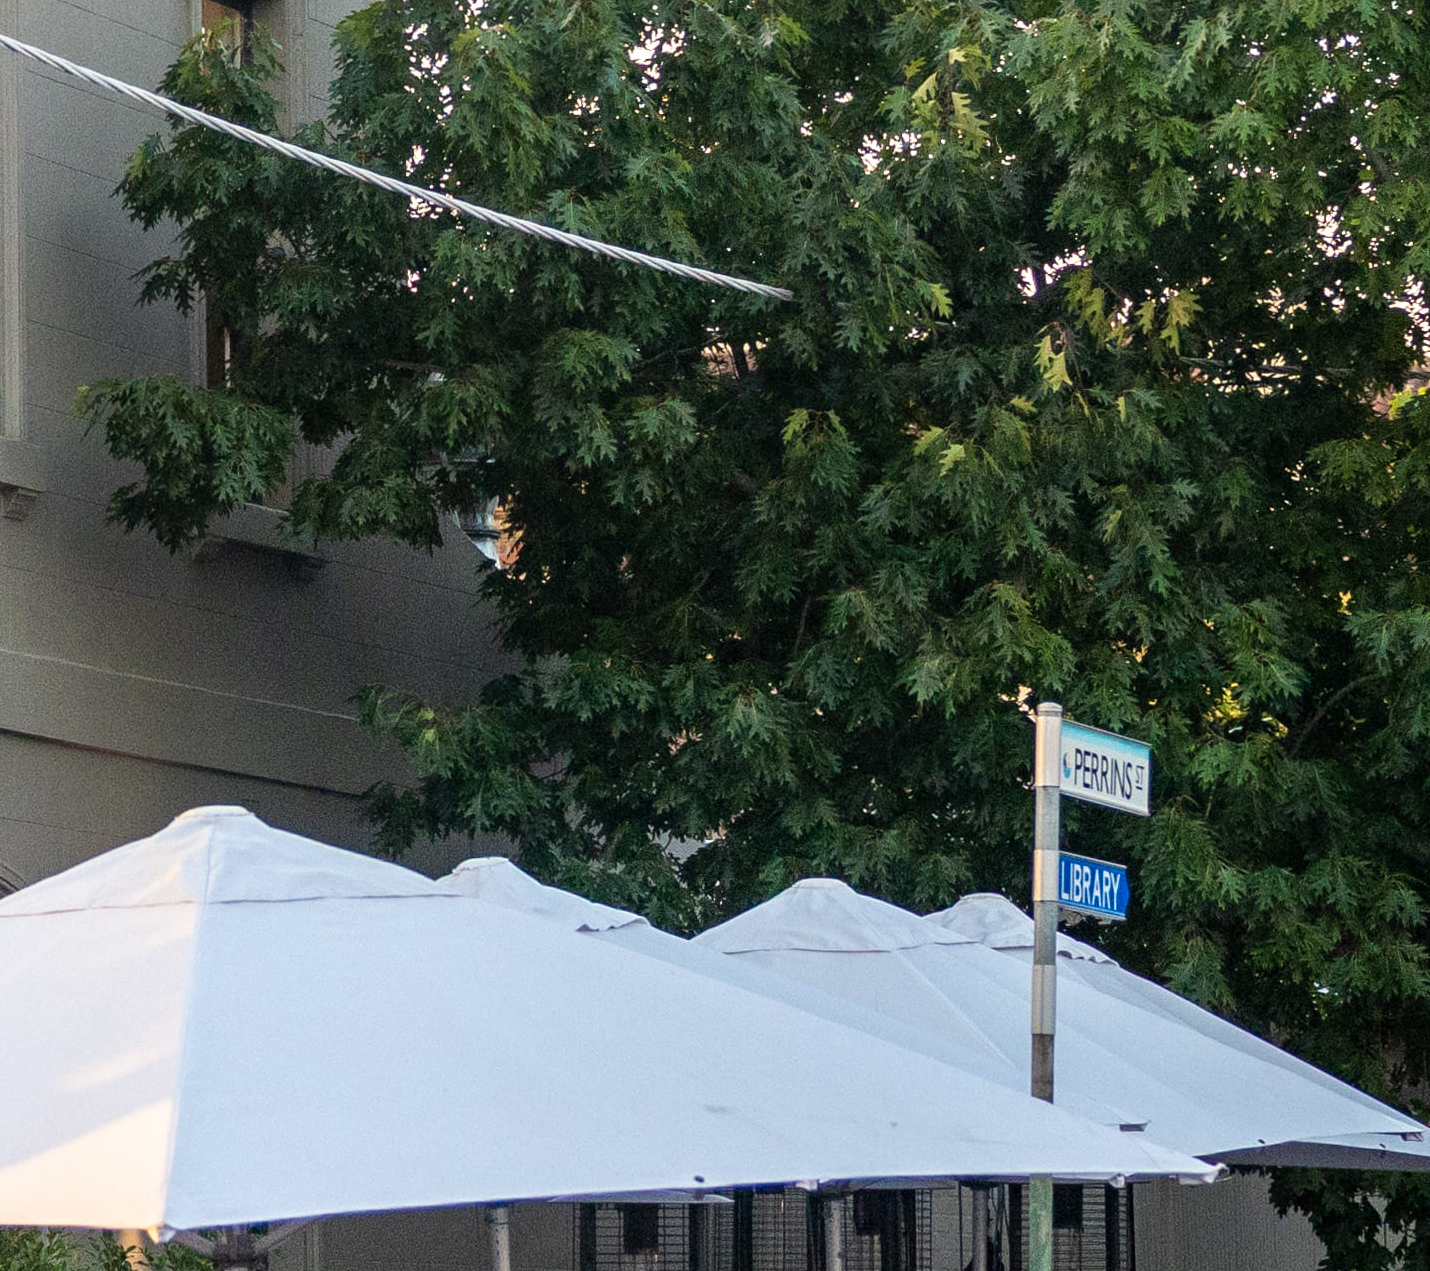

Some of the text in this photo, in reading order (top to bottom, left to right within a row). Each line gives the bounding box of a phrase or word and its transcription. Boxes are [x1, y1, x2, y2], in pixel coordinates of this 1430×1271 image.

[1073, 748, 1145, 800] PERRINS ST
[1061, 861, 1121, 911] LIBRARY
